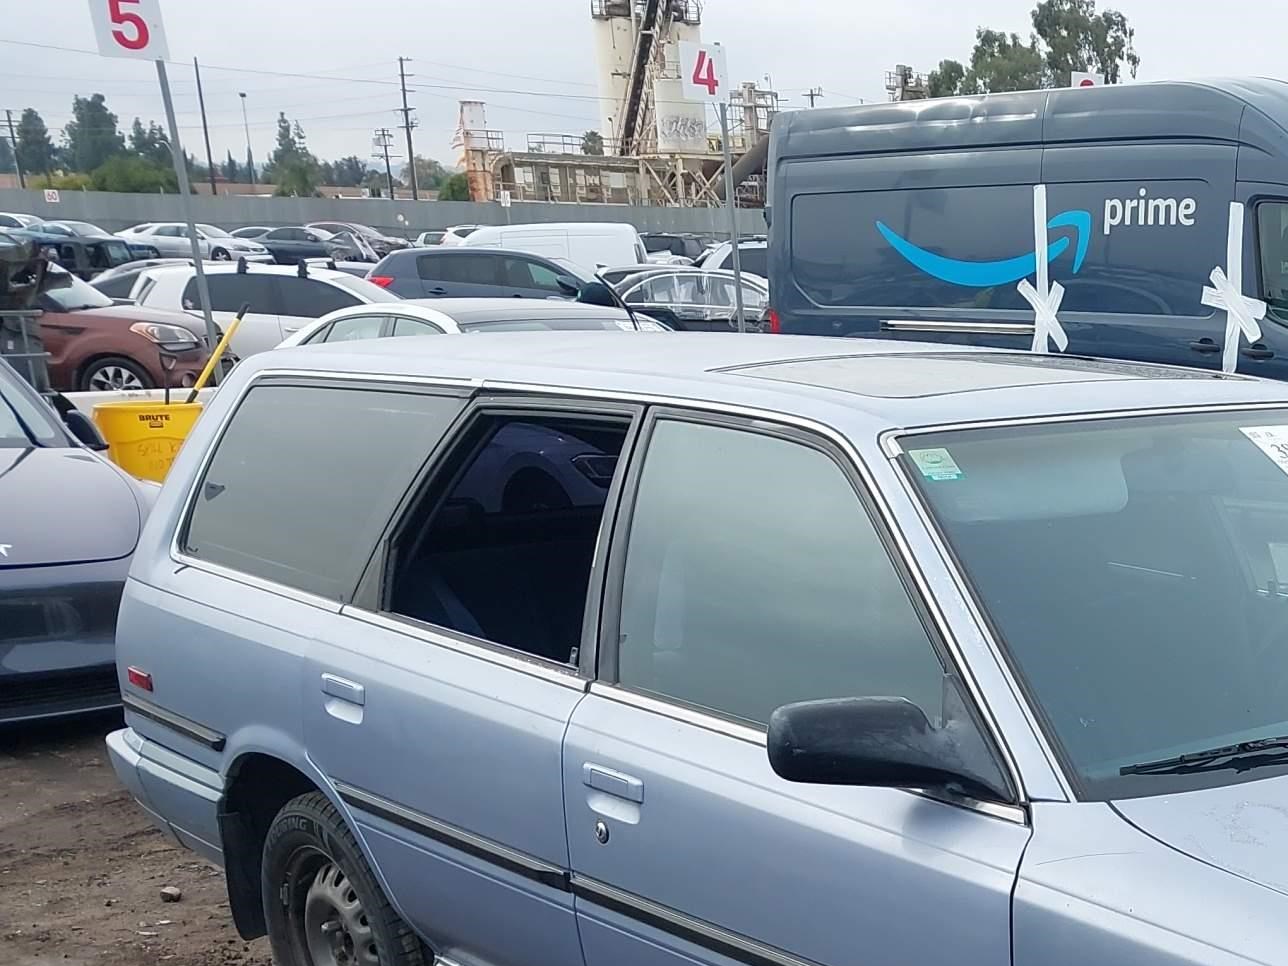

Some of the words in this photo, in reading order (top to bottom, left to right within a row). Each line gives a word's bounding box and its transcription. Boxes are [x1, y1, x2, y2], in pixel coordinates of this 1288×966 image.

[109, 0, 149, 49] 5
[692, 51, 719, 95] 4
[1103, 187, 1196, 235] prime
